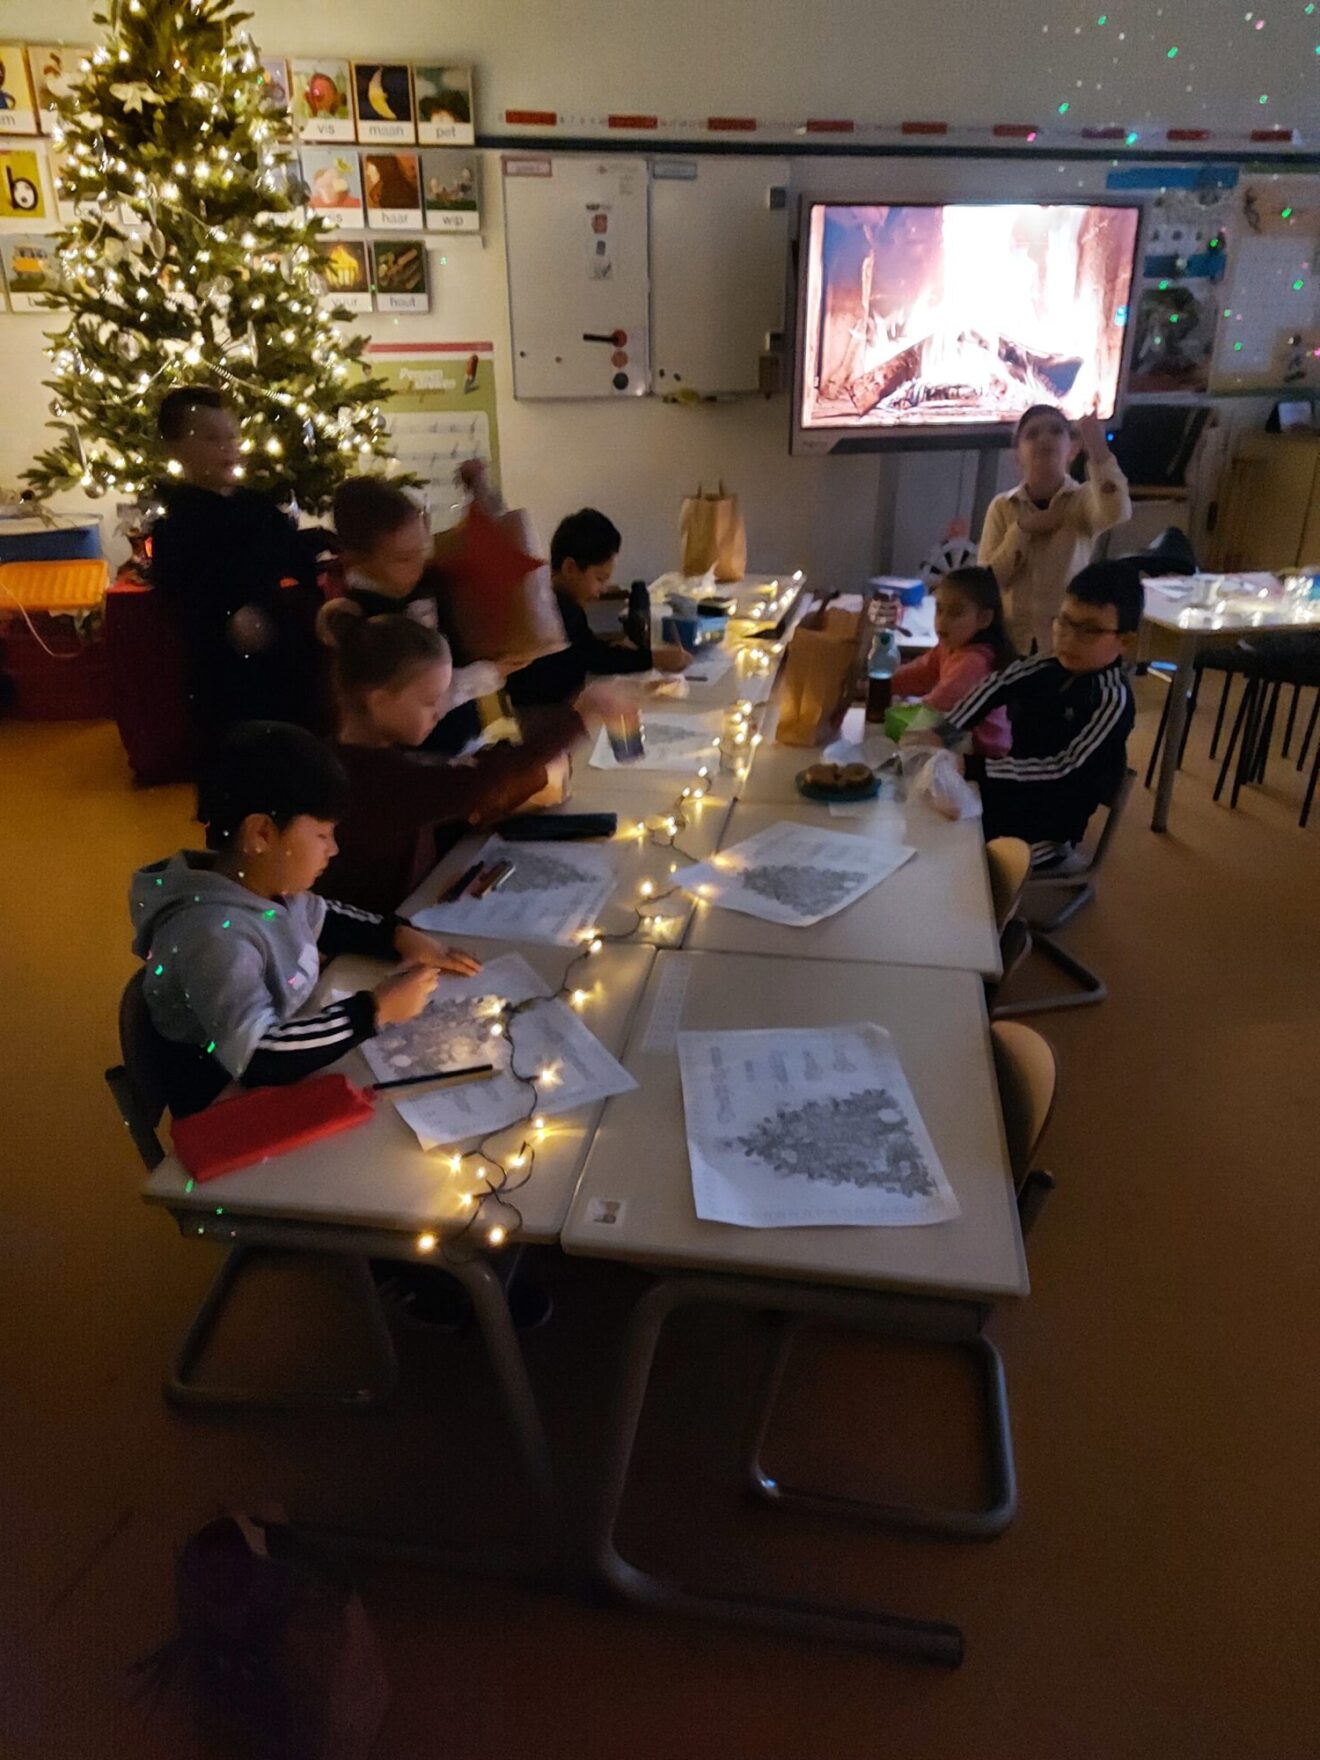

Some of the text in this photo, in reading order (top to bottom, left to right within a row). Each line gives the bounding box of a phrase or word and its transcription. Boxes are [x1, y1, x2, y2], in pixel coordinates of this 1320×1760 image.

[318, 124, 335, 135] vis
[369, 126, 404, 137] maan
[436, 126, 457, 138] pet
[6, 165, 38, 210] b
[381, 212, 408, 224] haar
